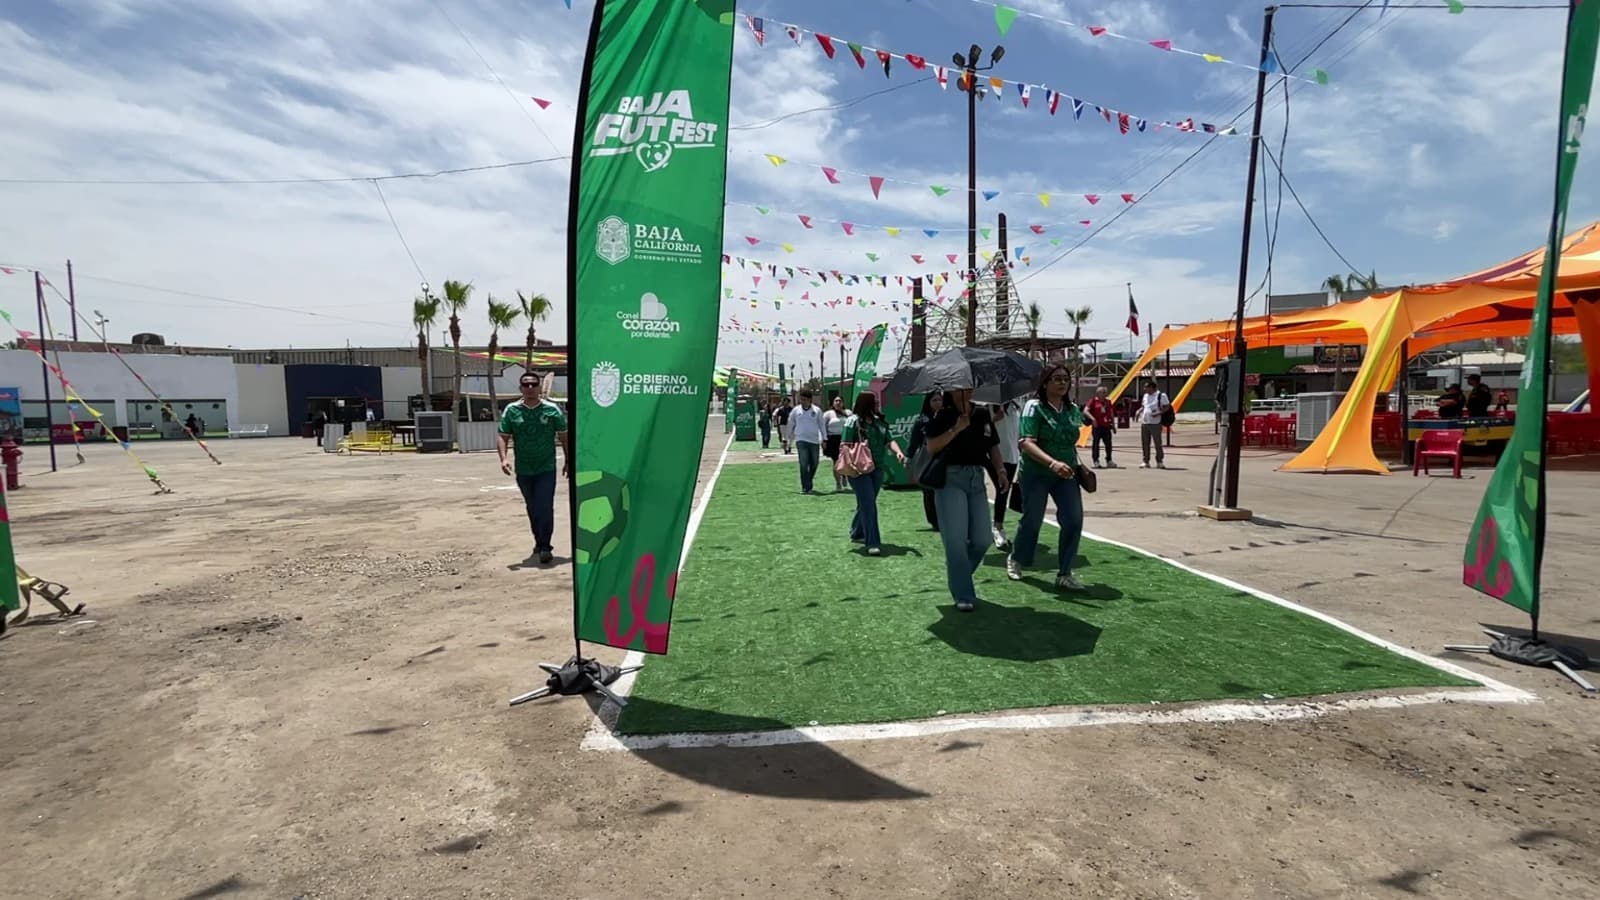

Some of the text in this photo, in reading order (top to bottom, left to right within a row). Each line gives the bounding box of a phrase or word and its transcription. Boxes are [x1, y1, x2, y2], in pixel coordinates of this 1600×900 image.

[618, 90, 693, 119] BAJA
[592, 113, 718, 145] FUT FEST
[635, 224, 684, 241] BAJA
[634, 239, 702, 253] CALIFORNIA
[622, 317, 680, 332] corazón
[631, 331, 643, 339] por
[623, 374, 688, 385] GOBIERNO
[623, 384, 698, 395] DE MEXICALI
